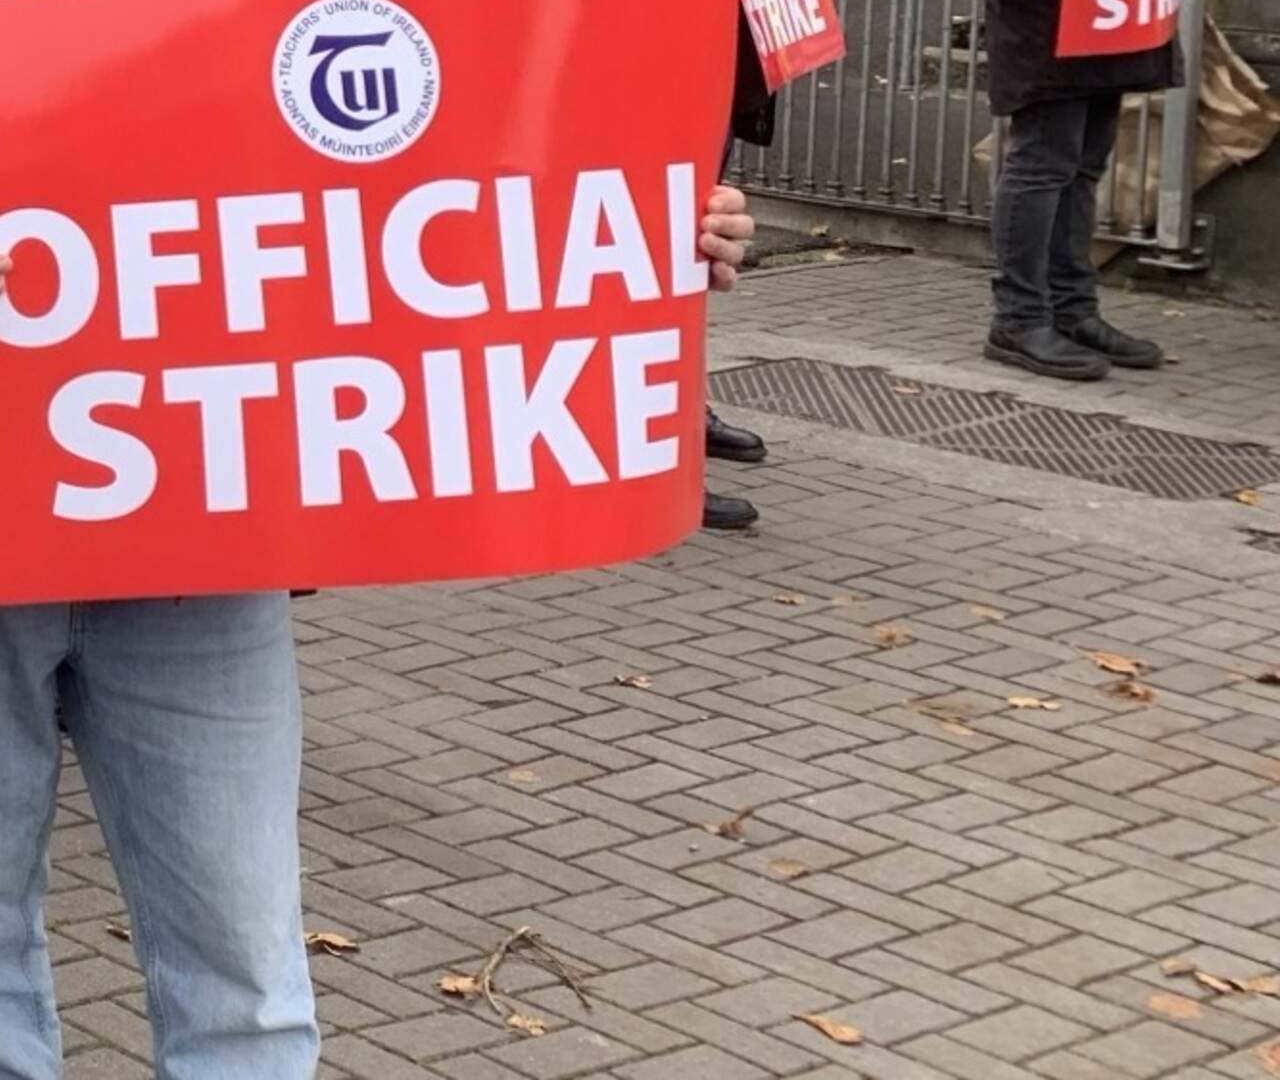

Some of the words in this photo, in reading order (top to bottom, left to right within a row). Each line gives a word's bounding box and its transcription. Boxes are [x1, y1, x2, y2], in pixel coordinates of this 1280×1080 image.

[373, 3, 392, 17] OF
[392, 13, 433, 68] IRELAND
[281, 88, 319, 141] AONTAS
[46, 327, 682, 522] STRIKE
